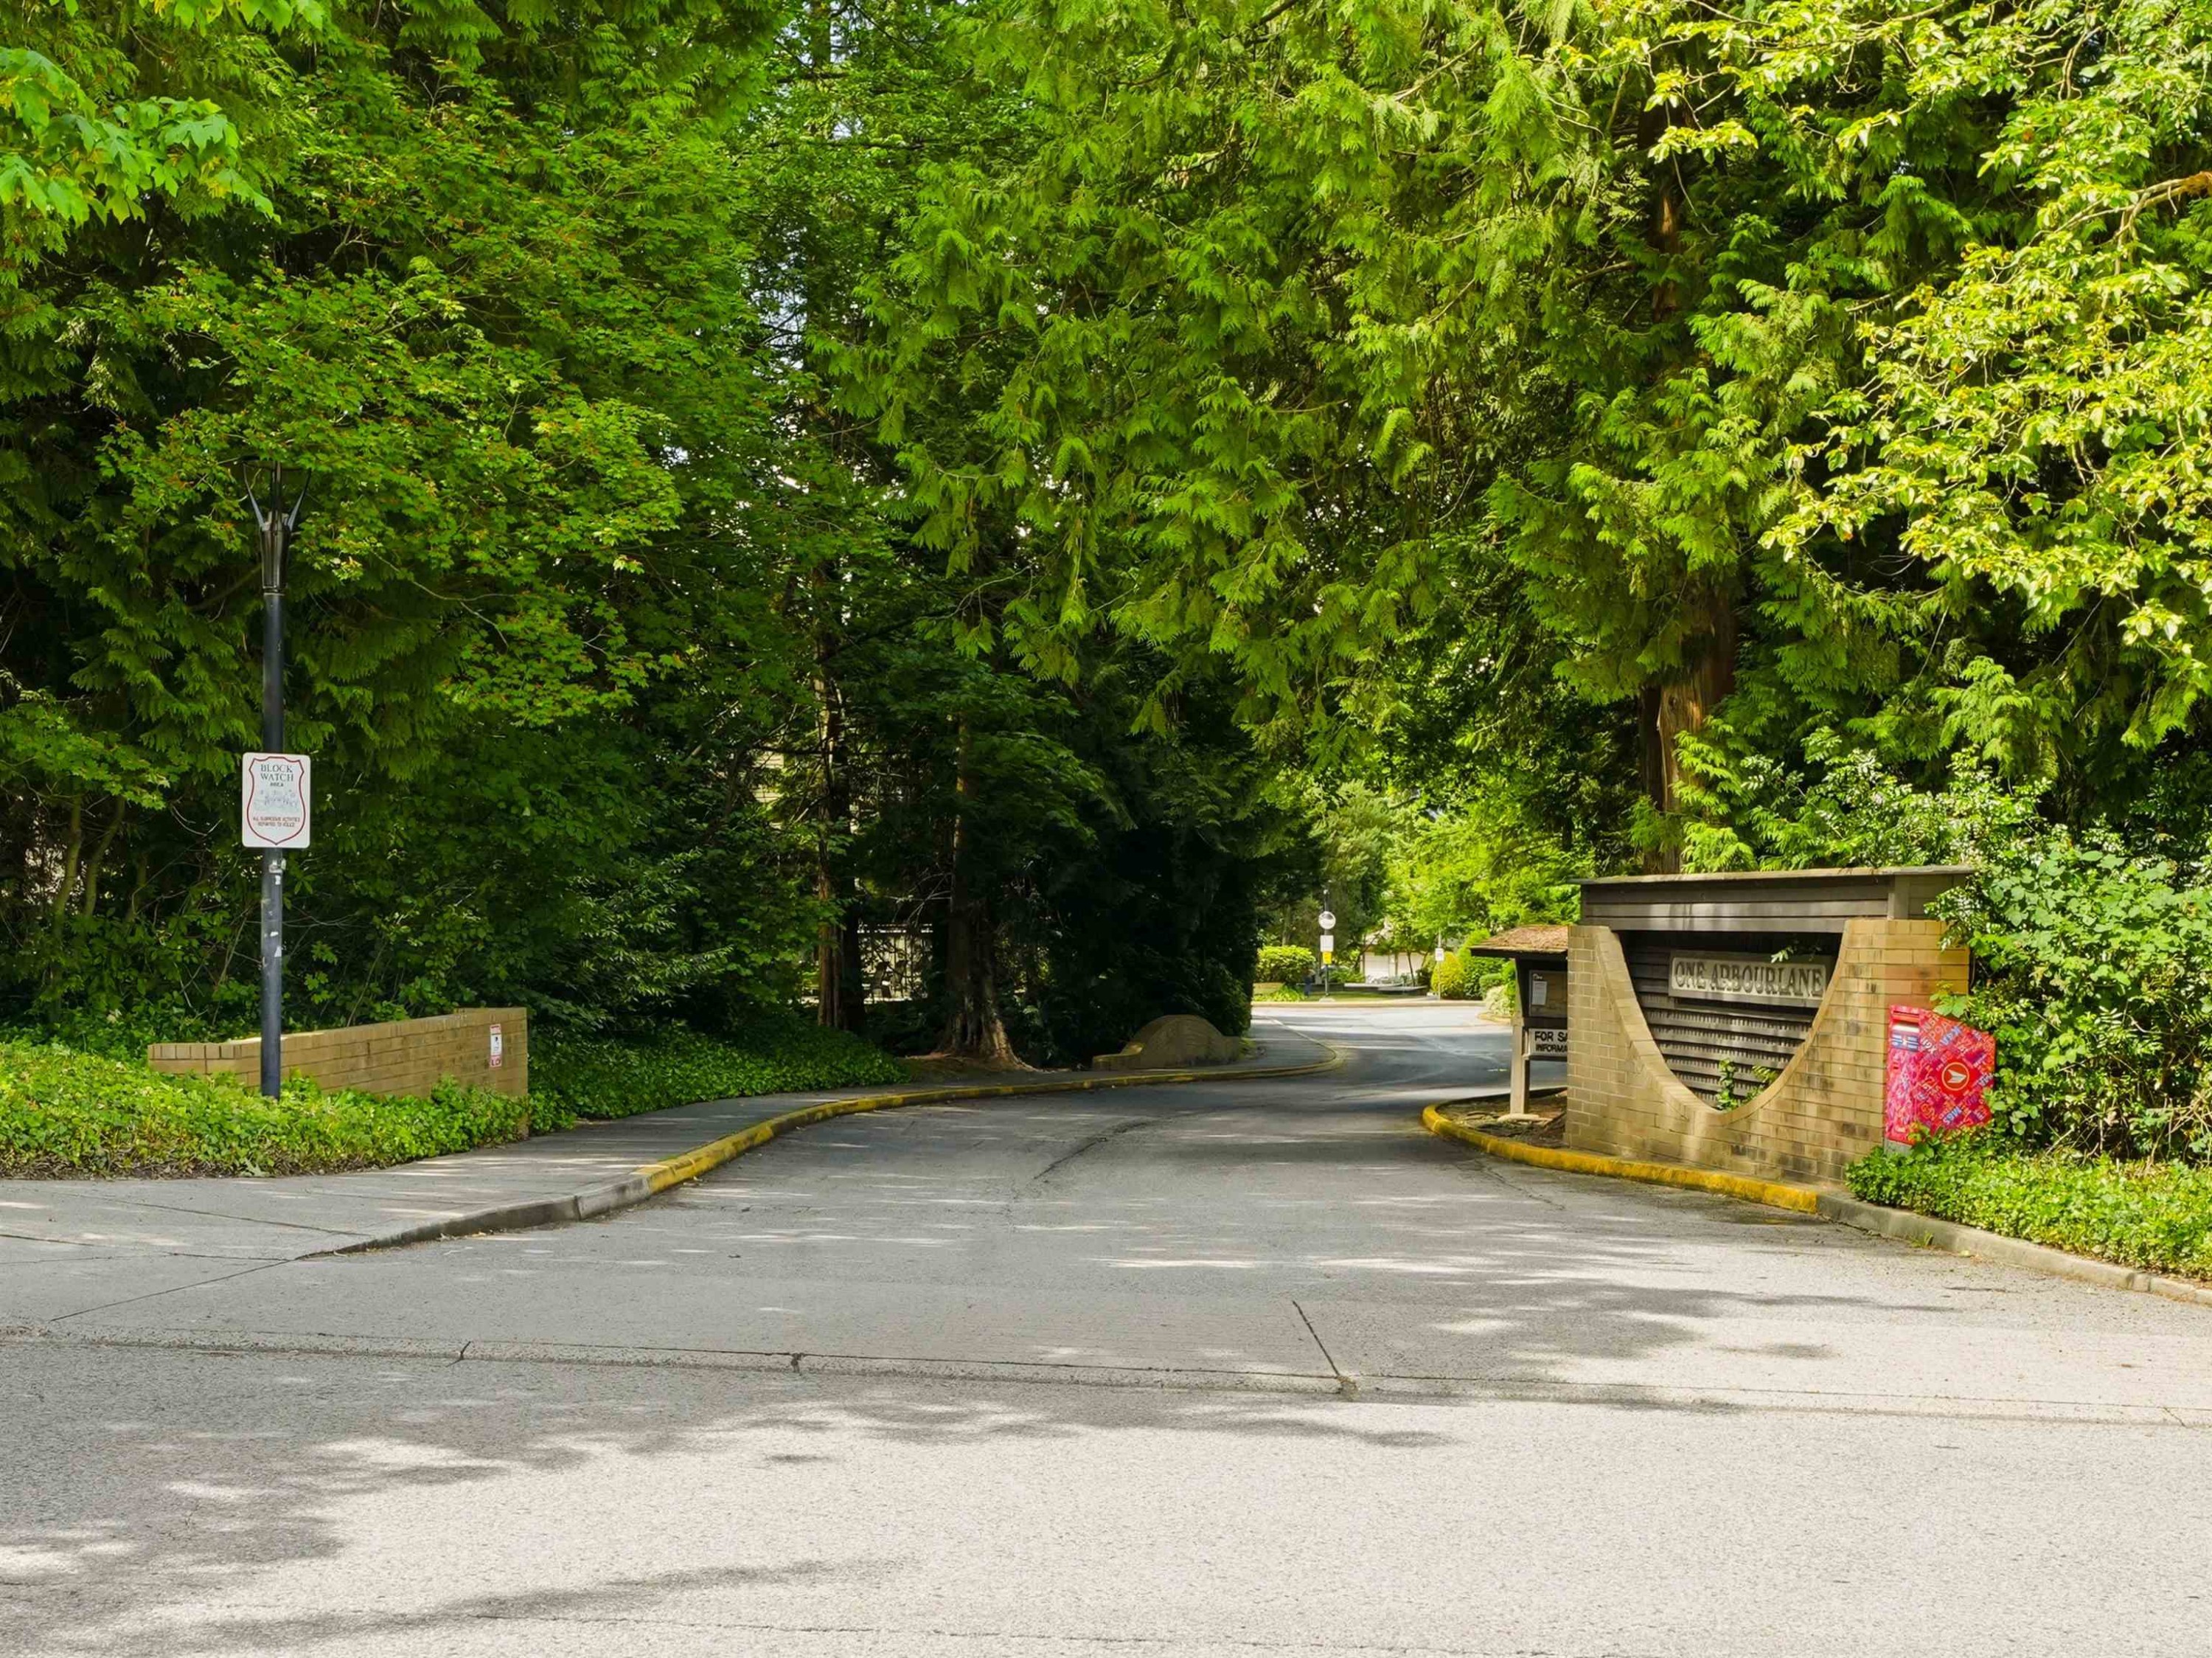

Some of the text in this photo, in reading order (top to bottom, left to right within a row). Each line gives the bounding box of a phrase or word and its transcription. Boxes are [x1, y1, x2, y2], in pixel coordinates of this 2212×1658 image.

[260, 763, 293, 773] BLOCK
[260, 773, 294, 782] WATCH
[1674, 961, 1706, 989] ONE
[1534, 1031, 1554, 1041] FOR
